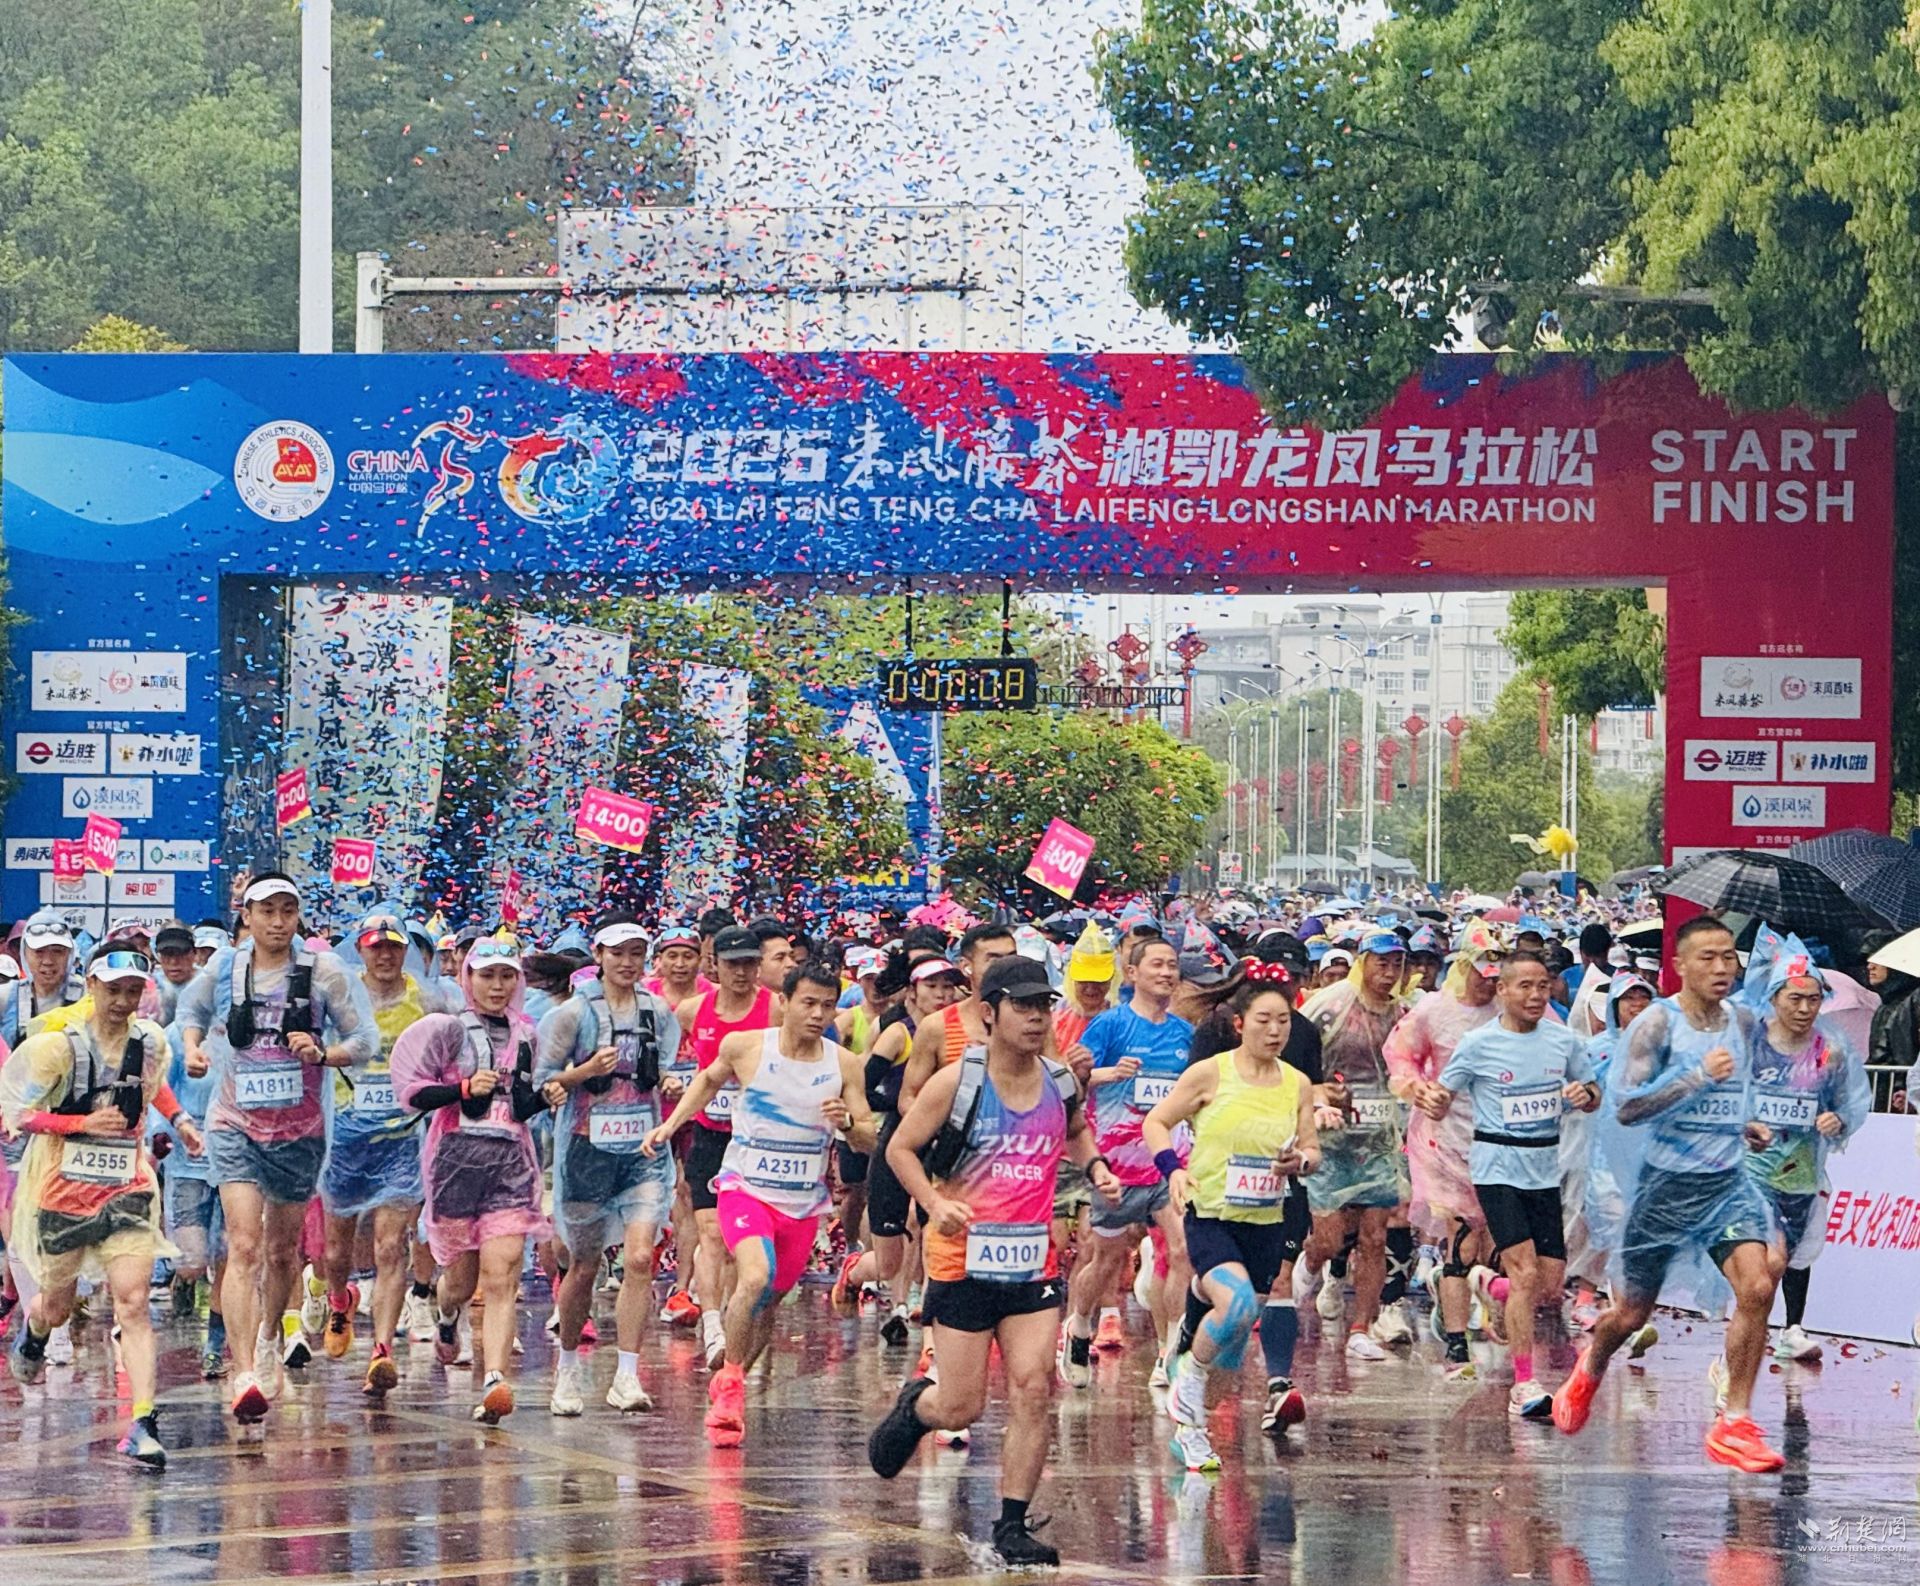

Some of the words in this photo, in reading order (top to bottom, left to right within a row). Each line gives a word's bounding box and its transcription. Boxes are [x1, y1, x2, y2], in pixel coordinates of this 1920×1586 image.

[1650, 428, 1858, 473] START
[347, 448, 429, 473] CHINA
[348, 473, 408, 481] MARATHON
[775, 497, 860, 522] FENG
[868, 497, 956, 523] TENG
[970, 497, 1039, 523] CHA
[1405, 497, 1597, 523] MARATHON
[1652, 480, 1855, 523] FINISH
[55, 741, 96, 759] 迈胜
[1725, 750, 1767, 766] 迈胜
[1810, 753, 1868, 771] 补水啦
[595, 807, 646, 837] 4:00
[14, 846, 54, 862] 勇闯天
[1049, 843, 1086, 879] 6:00
[245, 1078, 294, 1095] A1811
[1143, 1084, 1174, 1098] A16
[363, 1090, 394, 1104] A25
[710, 1095, 730, 1109] A0
[1360, 1104, 1390, 1117] A295
[1511, 1097, 1558, 1116] A1999
[1759, 1101, 1809, 1119] A1983
[600, 1119, 646, 1136] A2121
[71, 1150, 129, 1170] A2555
[757, 1156, 808, 1175] A2311
[991, 1162, 1044, 1182] PACER
[978, 1243, 1040, 1264] A0101
